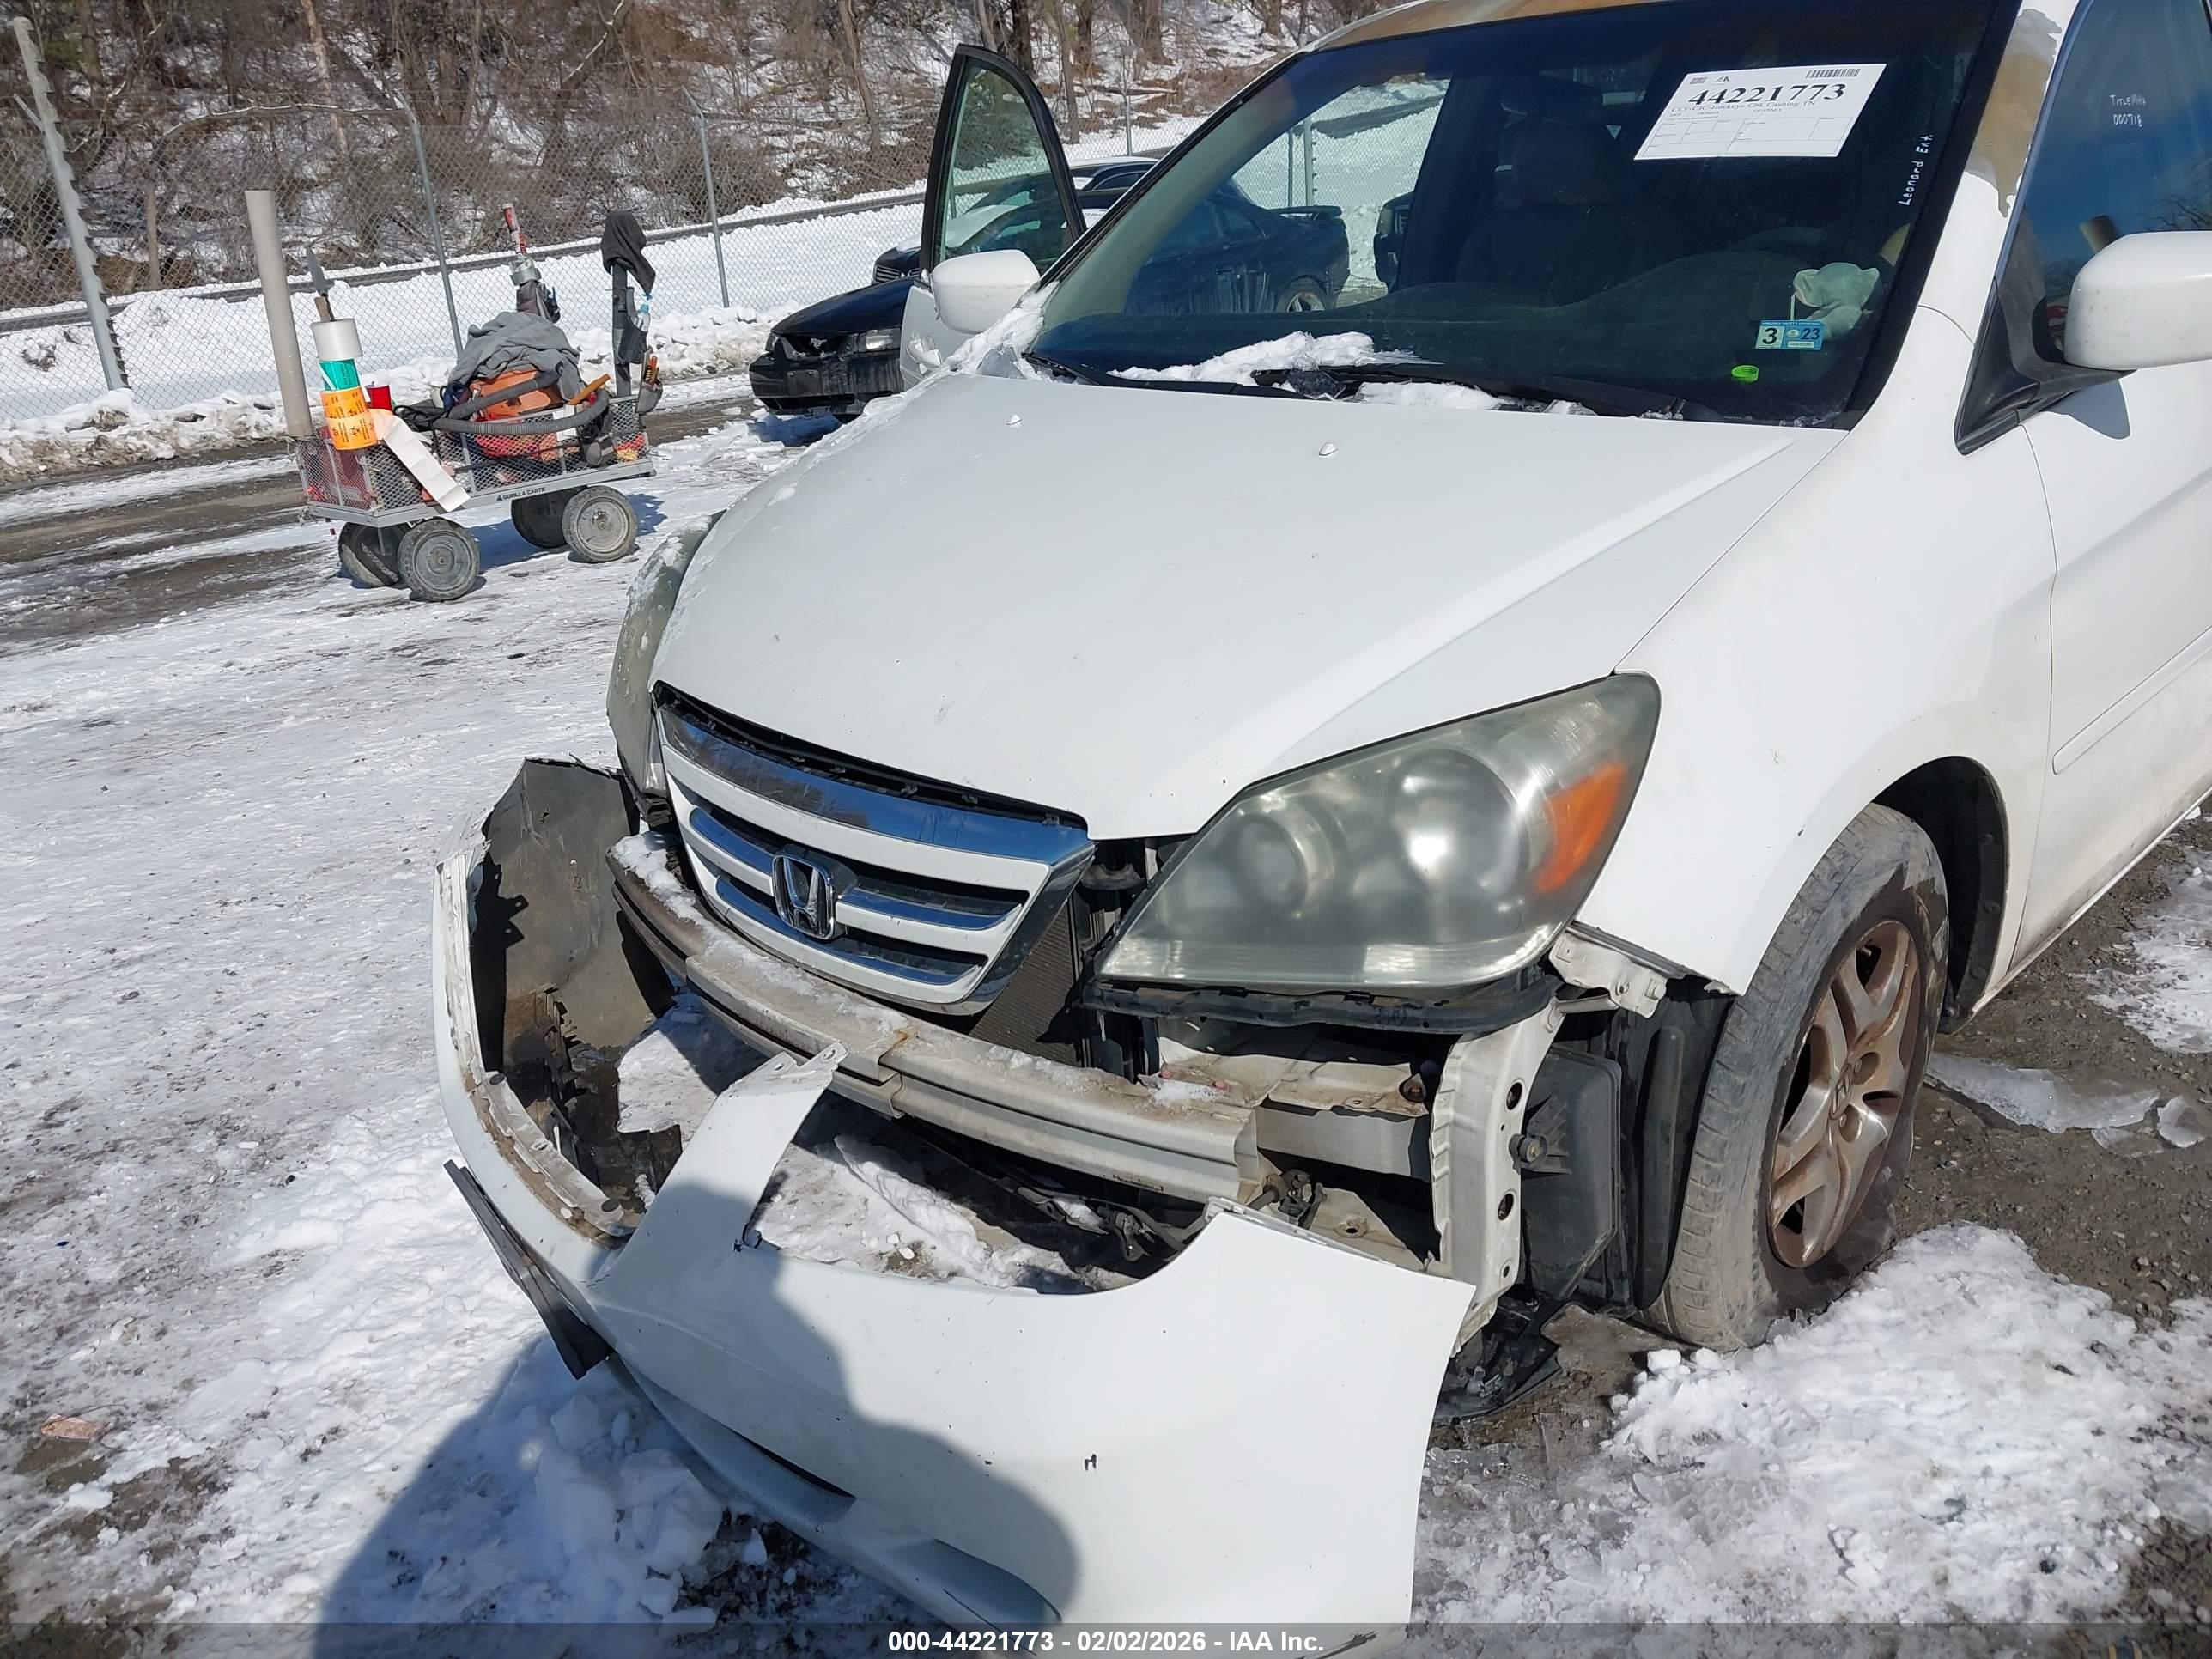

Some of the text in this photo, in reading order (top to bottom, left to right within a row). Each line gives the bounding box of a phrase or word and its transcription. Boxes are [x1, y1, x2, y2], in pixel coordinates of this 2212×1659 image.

[1688, 83, 1846, 106] 44221773
[2113, 113, 2143, 128] 000718
[1898, 161, 1924, 206] Leonard
[1762, 327, 1820, 345] 3 23
[503, 491, 526, 500] GORILLA
